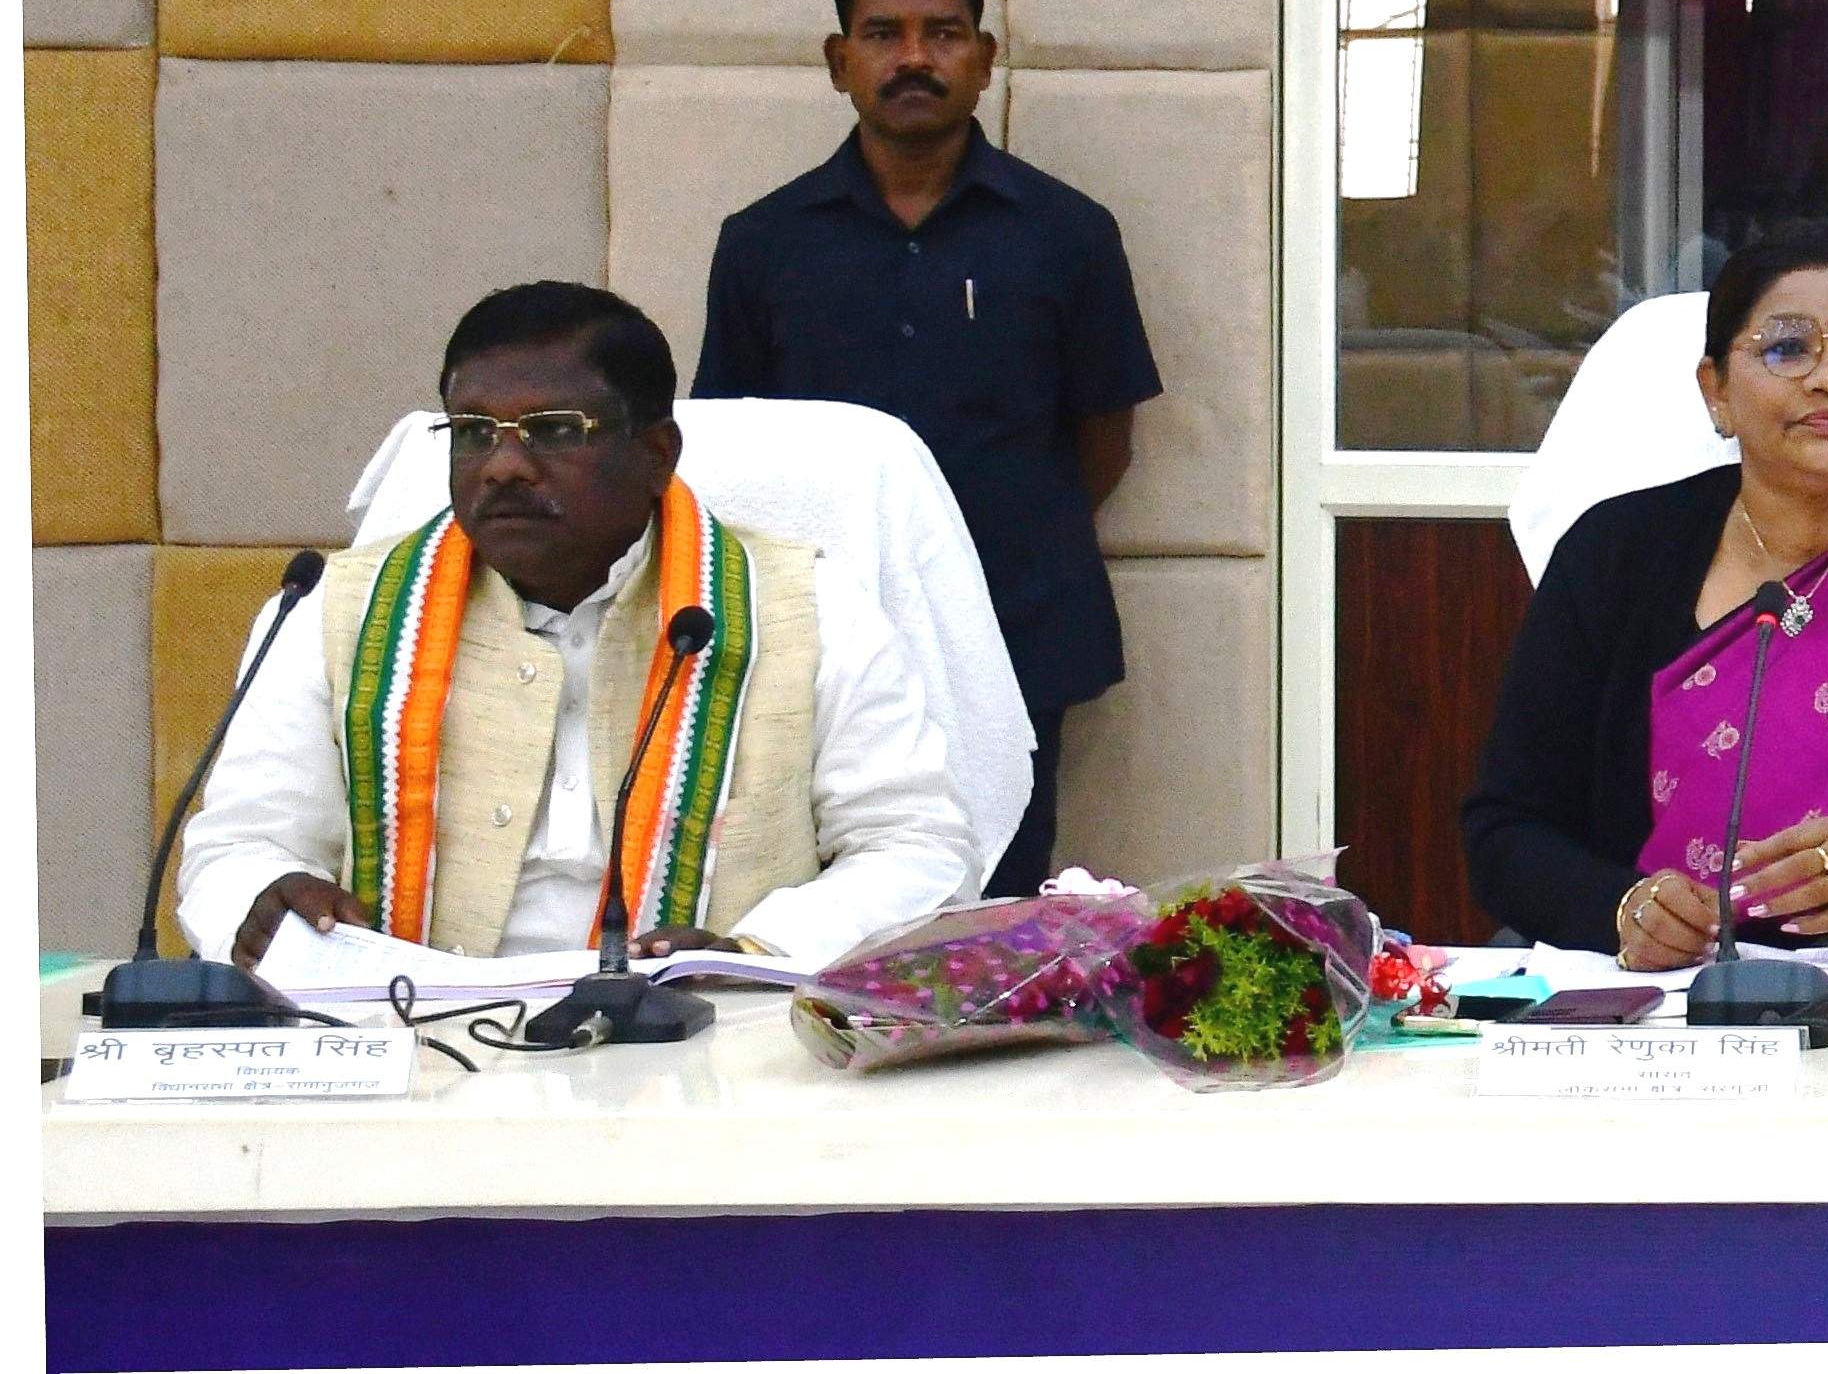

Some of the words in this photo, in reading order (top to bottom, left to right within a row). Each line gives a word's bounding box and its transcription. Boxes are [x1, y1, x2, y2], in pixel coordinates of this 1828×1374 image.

[79, 1038, 128, 1061] श्री
[152, 1041, 289, 1065] बृहस्पत
[314, 1034, 391, 1058] सिंह
[1492, 1035, 1588, 1056] श्रीमती
[1609, 1034, 1698, 1061] रेणुका
[1718, 1033, 1781, 1056] सिंह
